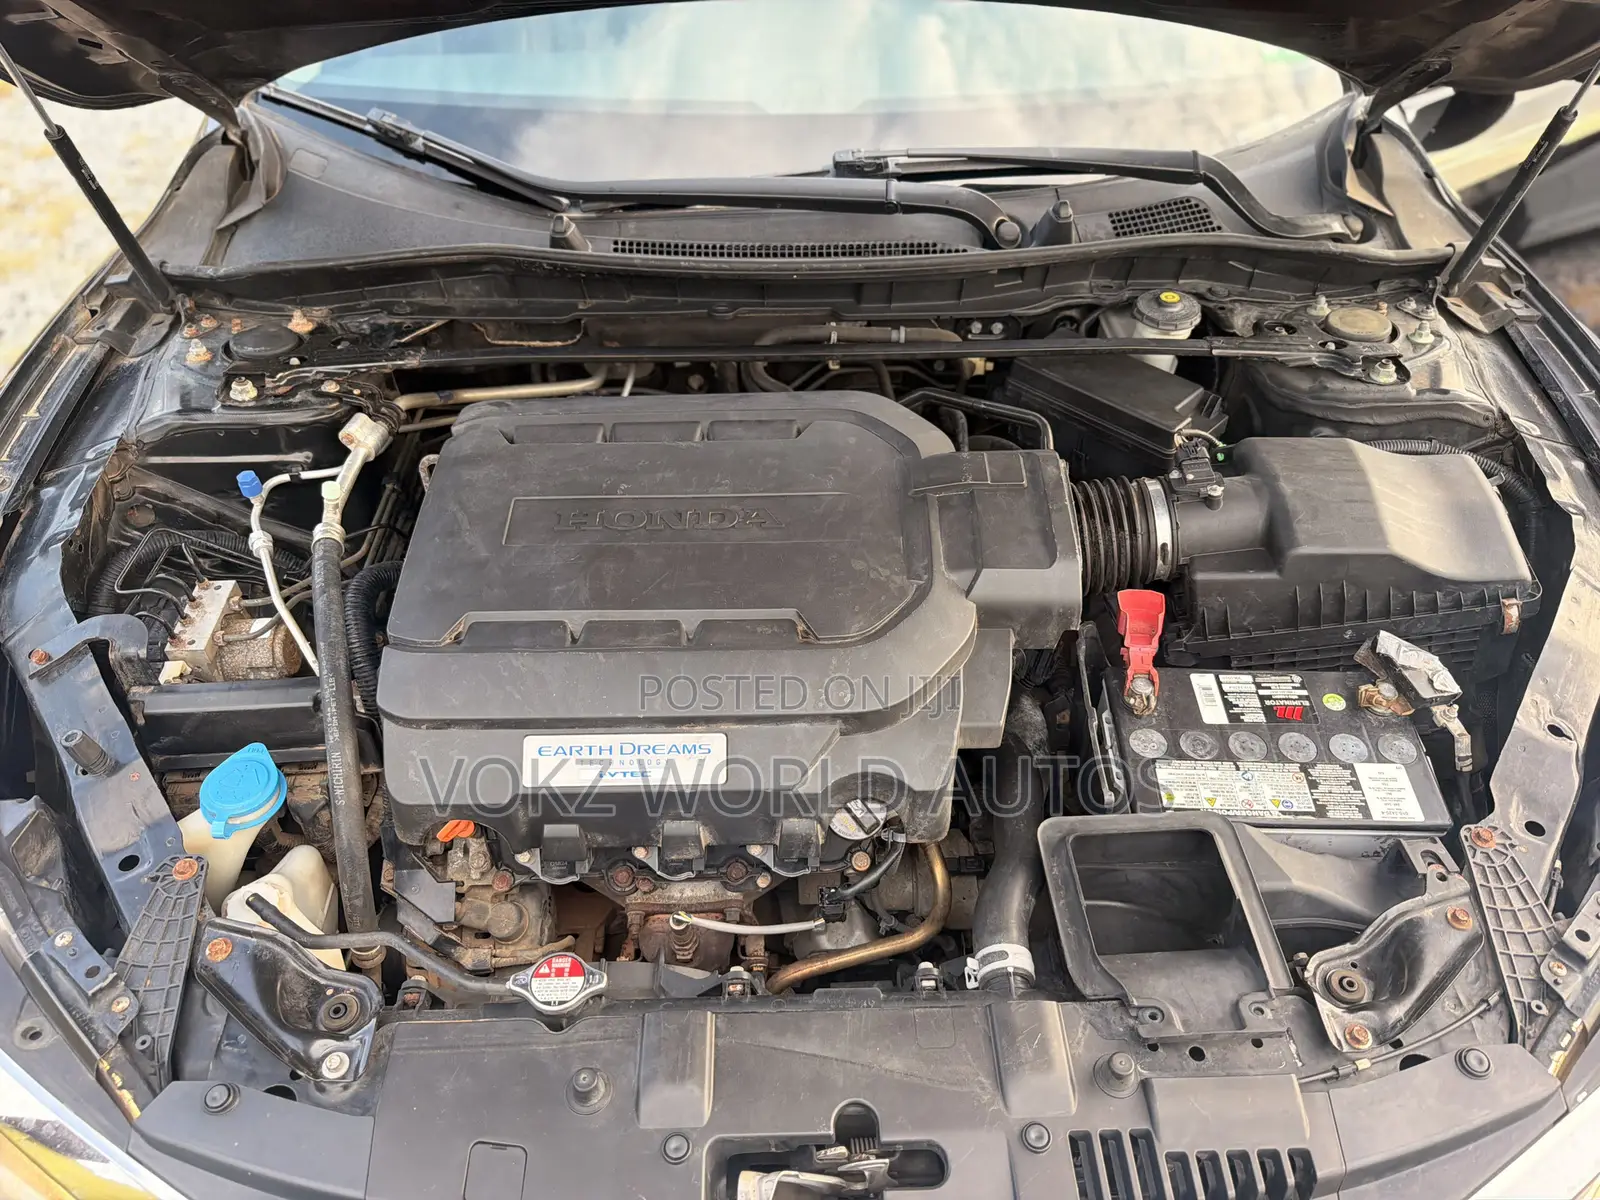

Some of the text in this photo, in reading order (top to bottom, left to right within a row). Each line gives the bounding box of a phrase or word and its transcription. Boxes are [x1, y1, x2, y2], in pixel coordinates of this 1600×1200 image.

[553, 507, 785, 532] HONDA
[538, 742, 712, 756] EARTH DREAMS
